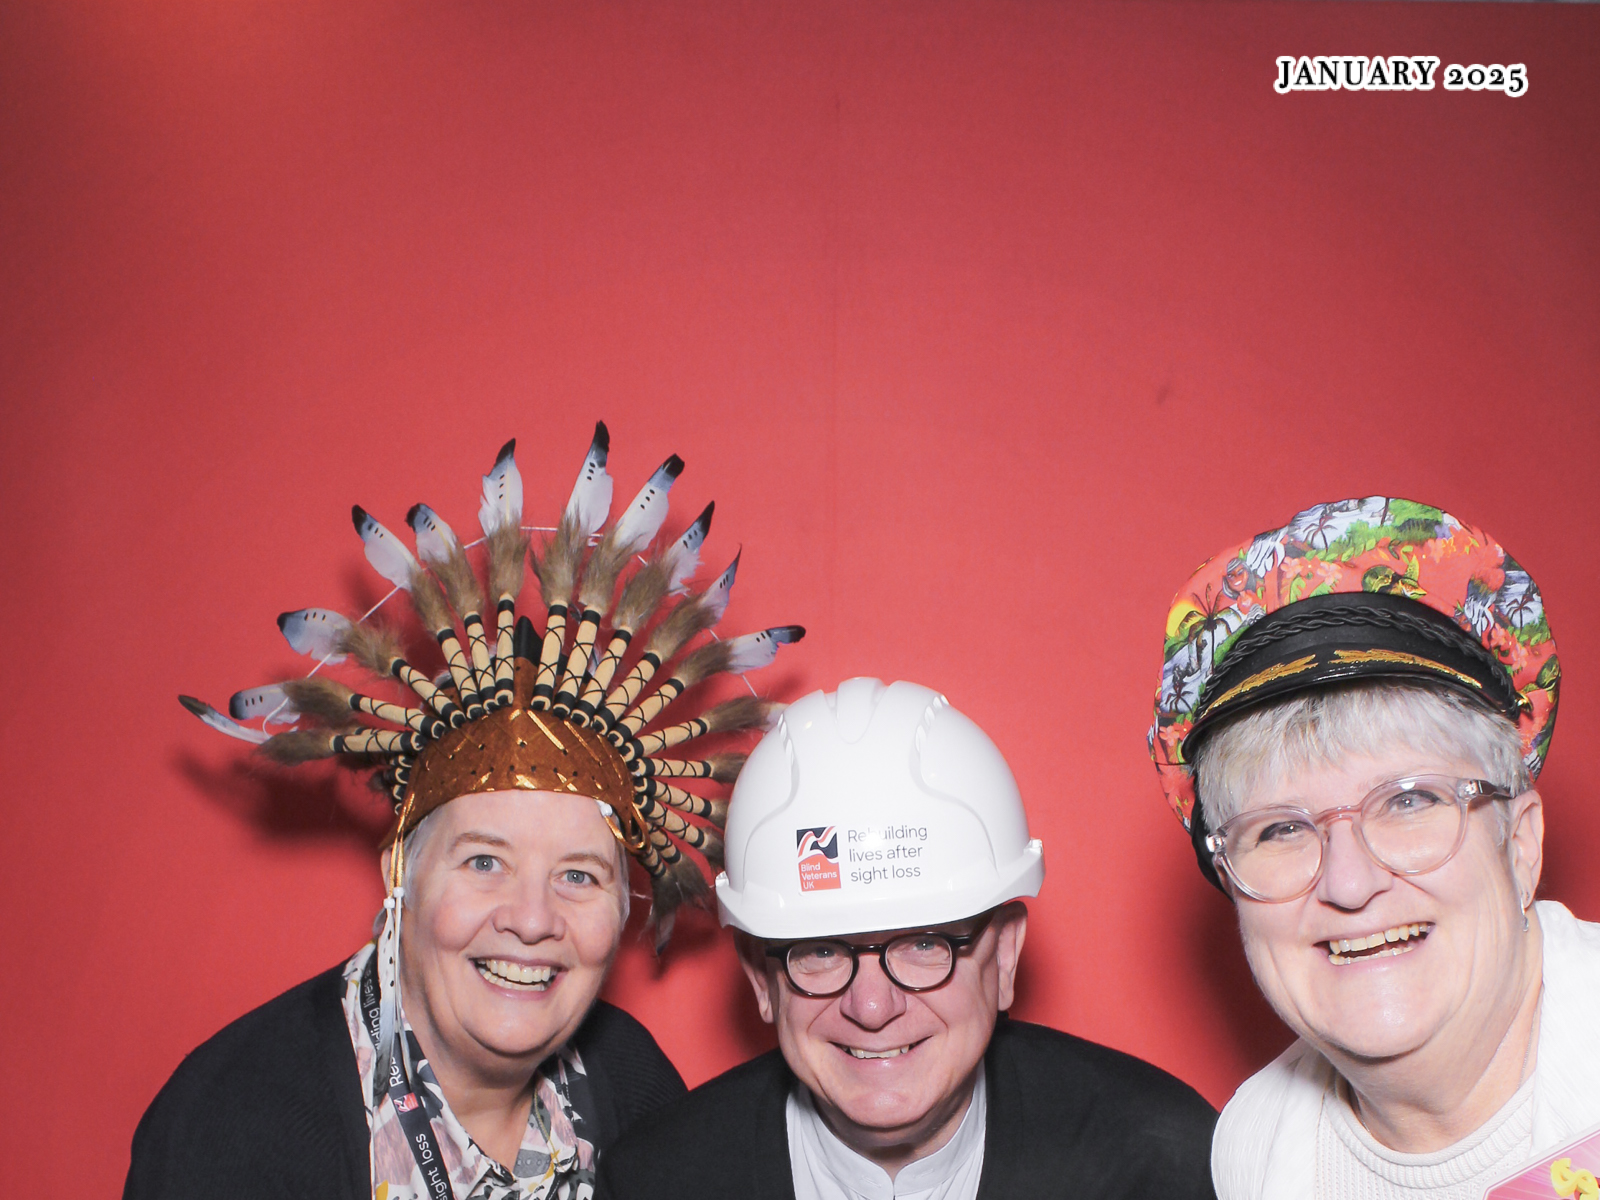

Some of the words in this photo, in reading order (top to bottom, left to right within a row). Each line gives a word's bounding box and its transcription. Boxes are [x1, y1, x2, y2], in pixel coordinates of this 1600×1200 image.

[849, 847, 883, 863] lives
[886, 845, 923, 860] after
[801, 862, 821, 872] Blind
[801, 871, 838, 881] Veterans
[850, 865, 889, 885] sight
[892, 865, 921, 879] loss
[803, 881, 815, 890] UK
[415, 1133, 434, 1166] loss
